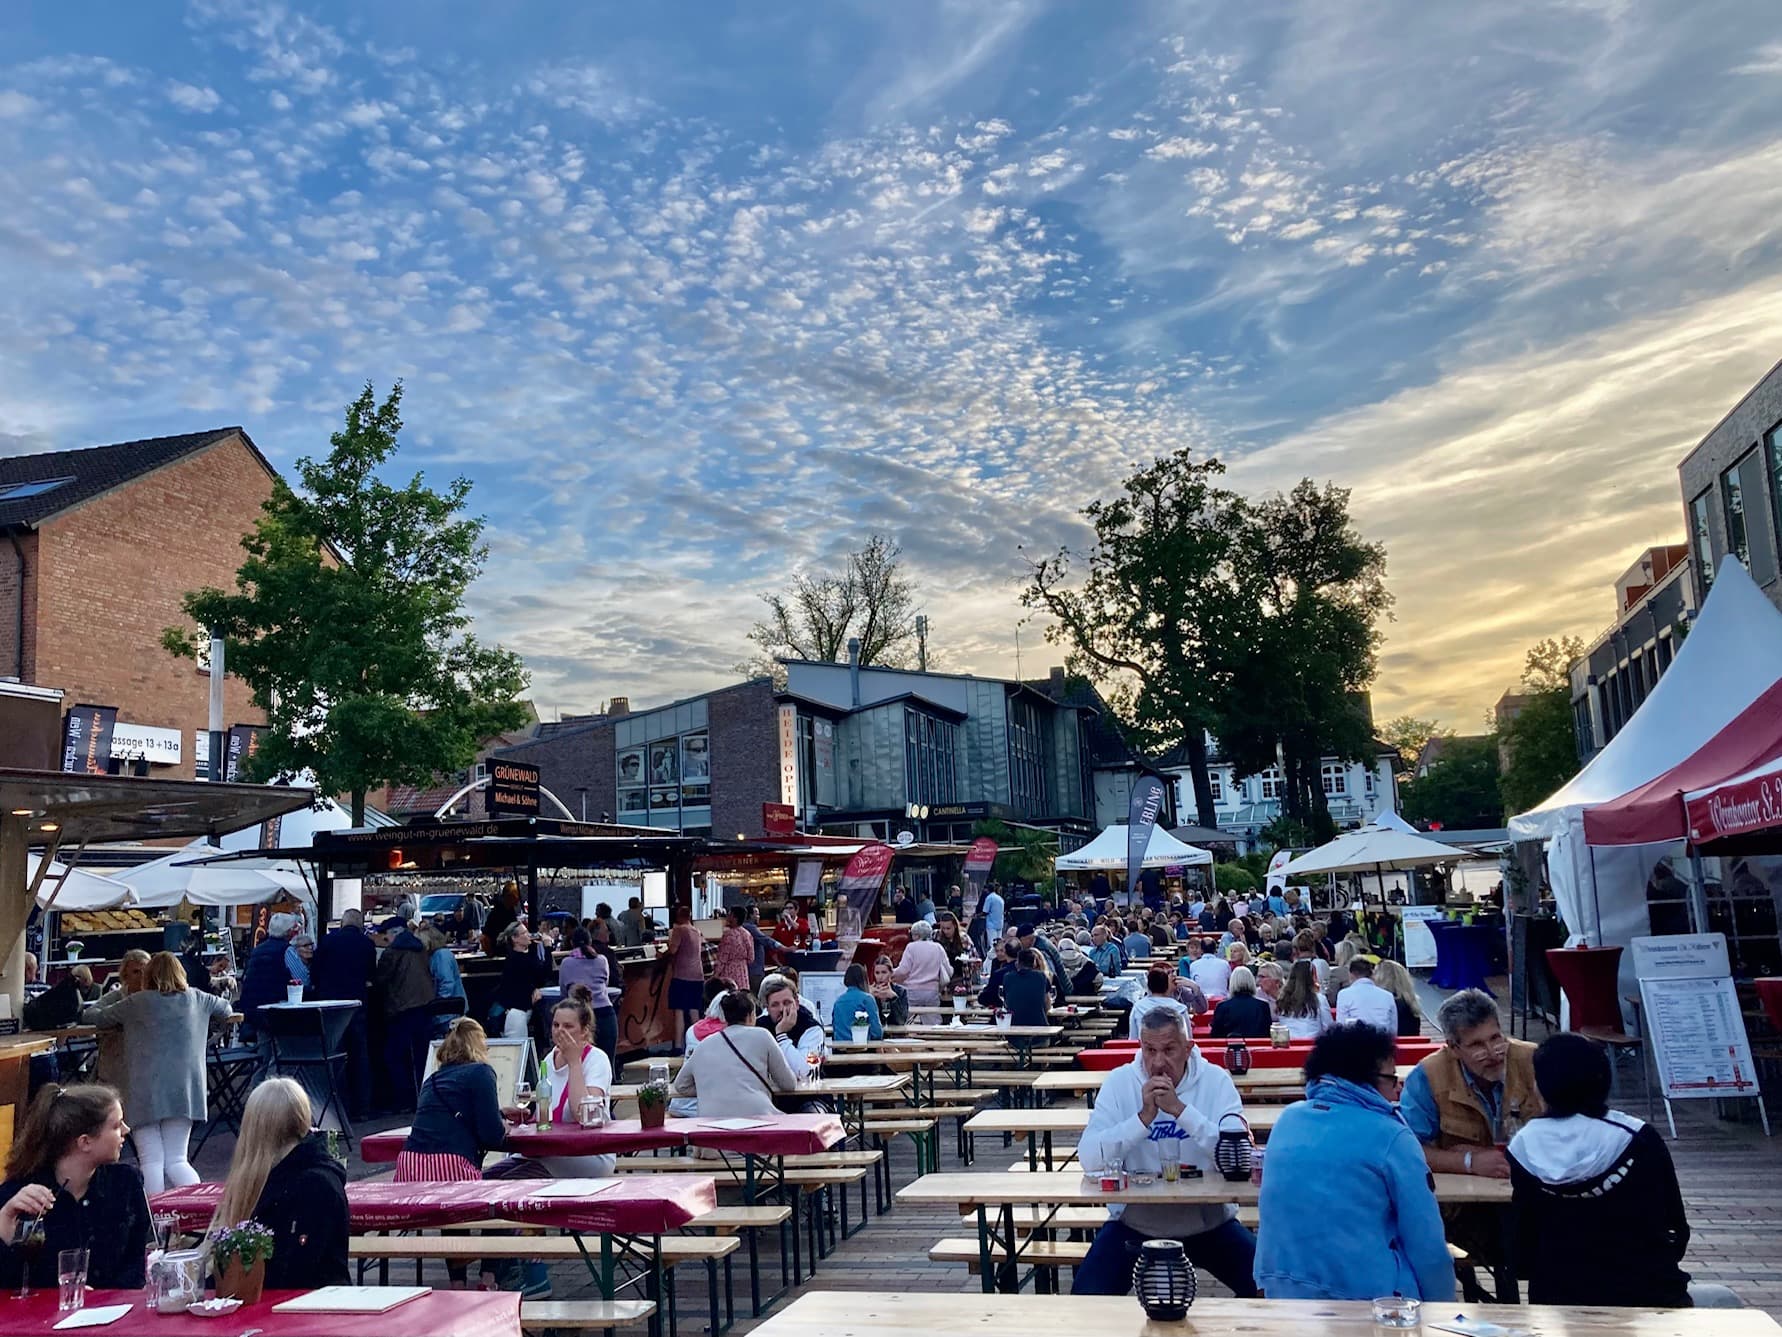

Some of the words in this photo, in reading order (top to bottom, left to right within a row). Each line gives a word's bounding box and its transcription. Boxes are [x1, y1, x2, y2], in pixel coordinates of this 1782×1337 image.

[783, 709, 793, 758] HEIDE
[112, 736, 143, 750] assage
[146, 738, 155, 749] 13
[164, 739, 179, 751] 13a
[494, 765, 538, 783] GRÜNEWALD
[495, 792, 516, 805] Michael
[521, 795, 537, 807] Söhne
[1139, 785, 1164, 827] EBLING
[933, 806, 966, 816] CANTINELLA
